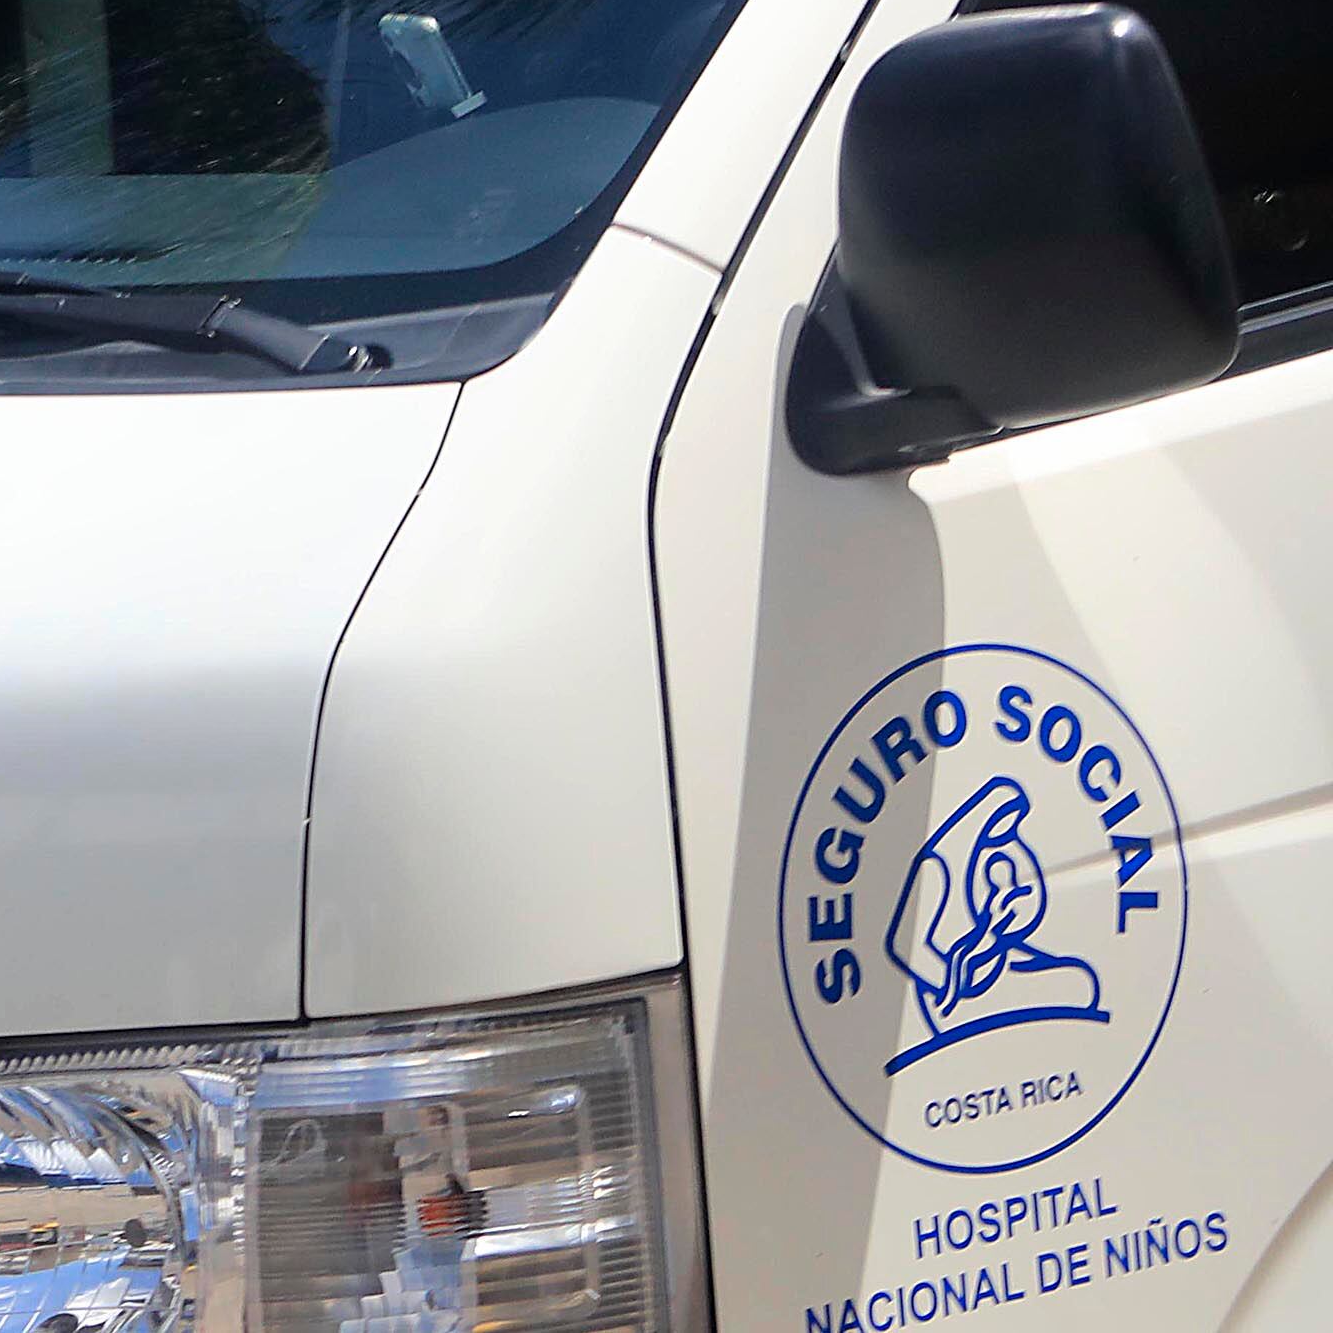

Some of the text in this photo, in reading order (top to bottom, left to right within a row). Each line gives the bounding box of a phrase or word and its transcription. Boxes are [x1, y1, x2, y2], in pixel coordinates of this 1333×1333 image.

[808, 685, 1160, 1006] SEGURO SOCIAL
[924, 1071, 1083, 1129] COSTA RICA
[913, 1178, 1118, 1260] HOSPITAL
[805, 1210, 1230, 1333] NACIONAL DE NIÑOS
